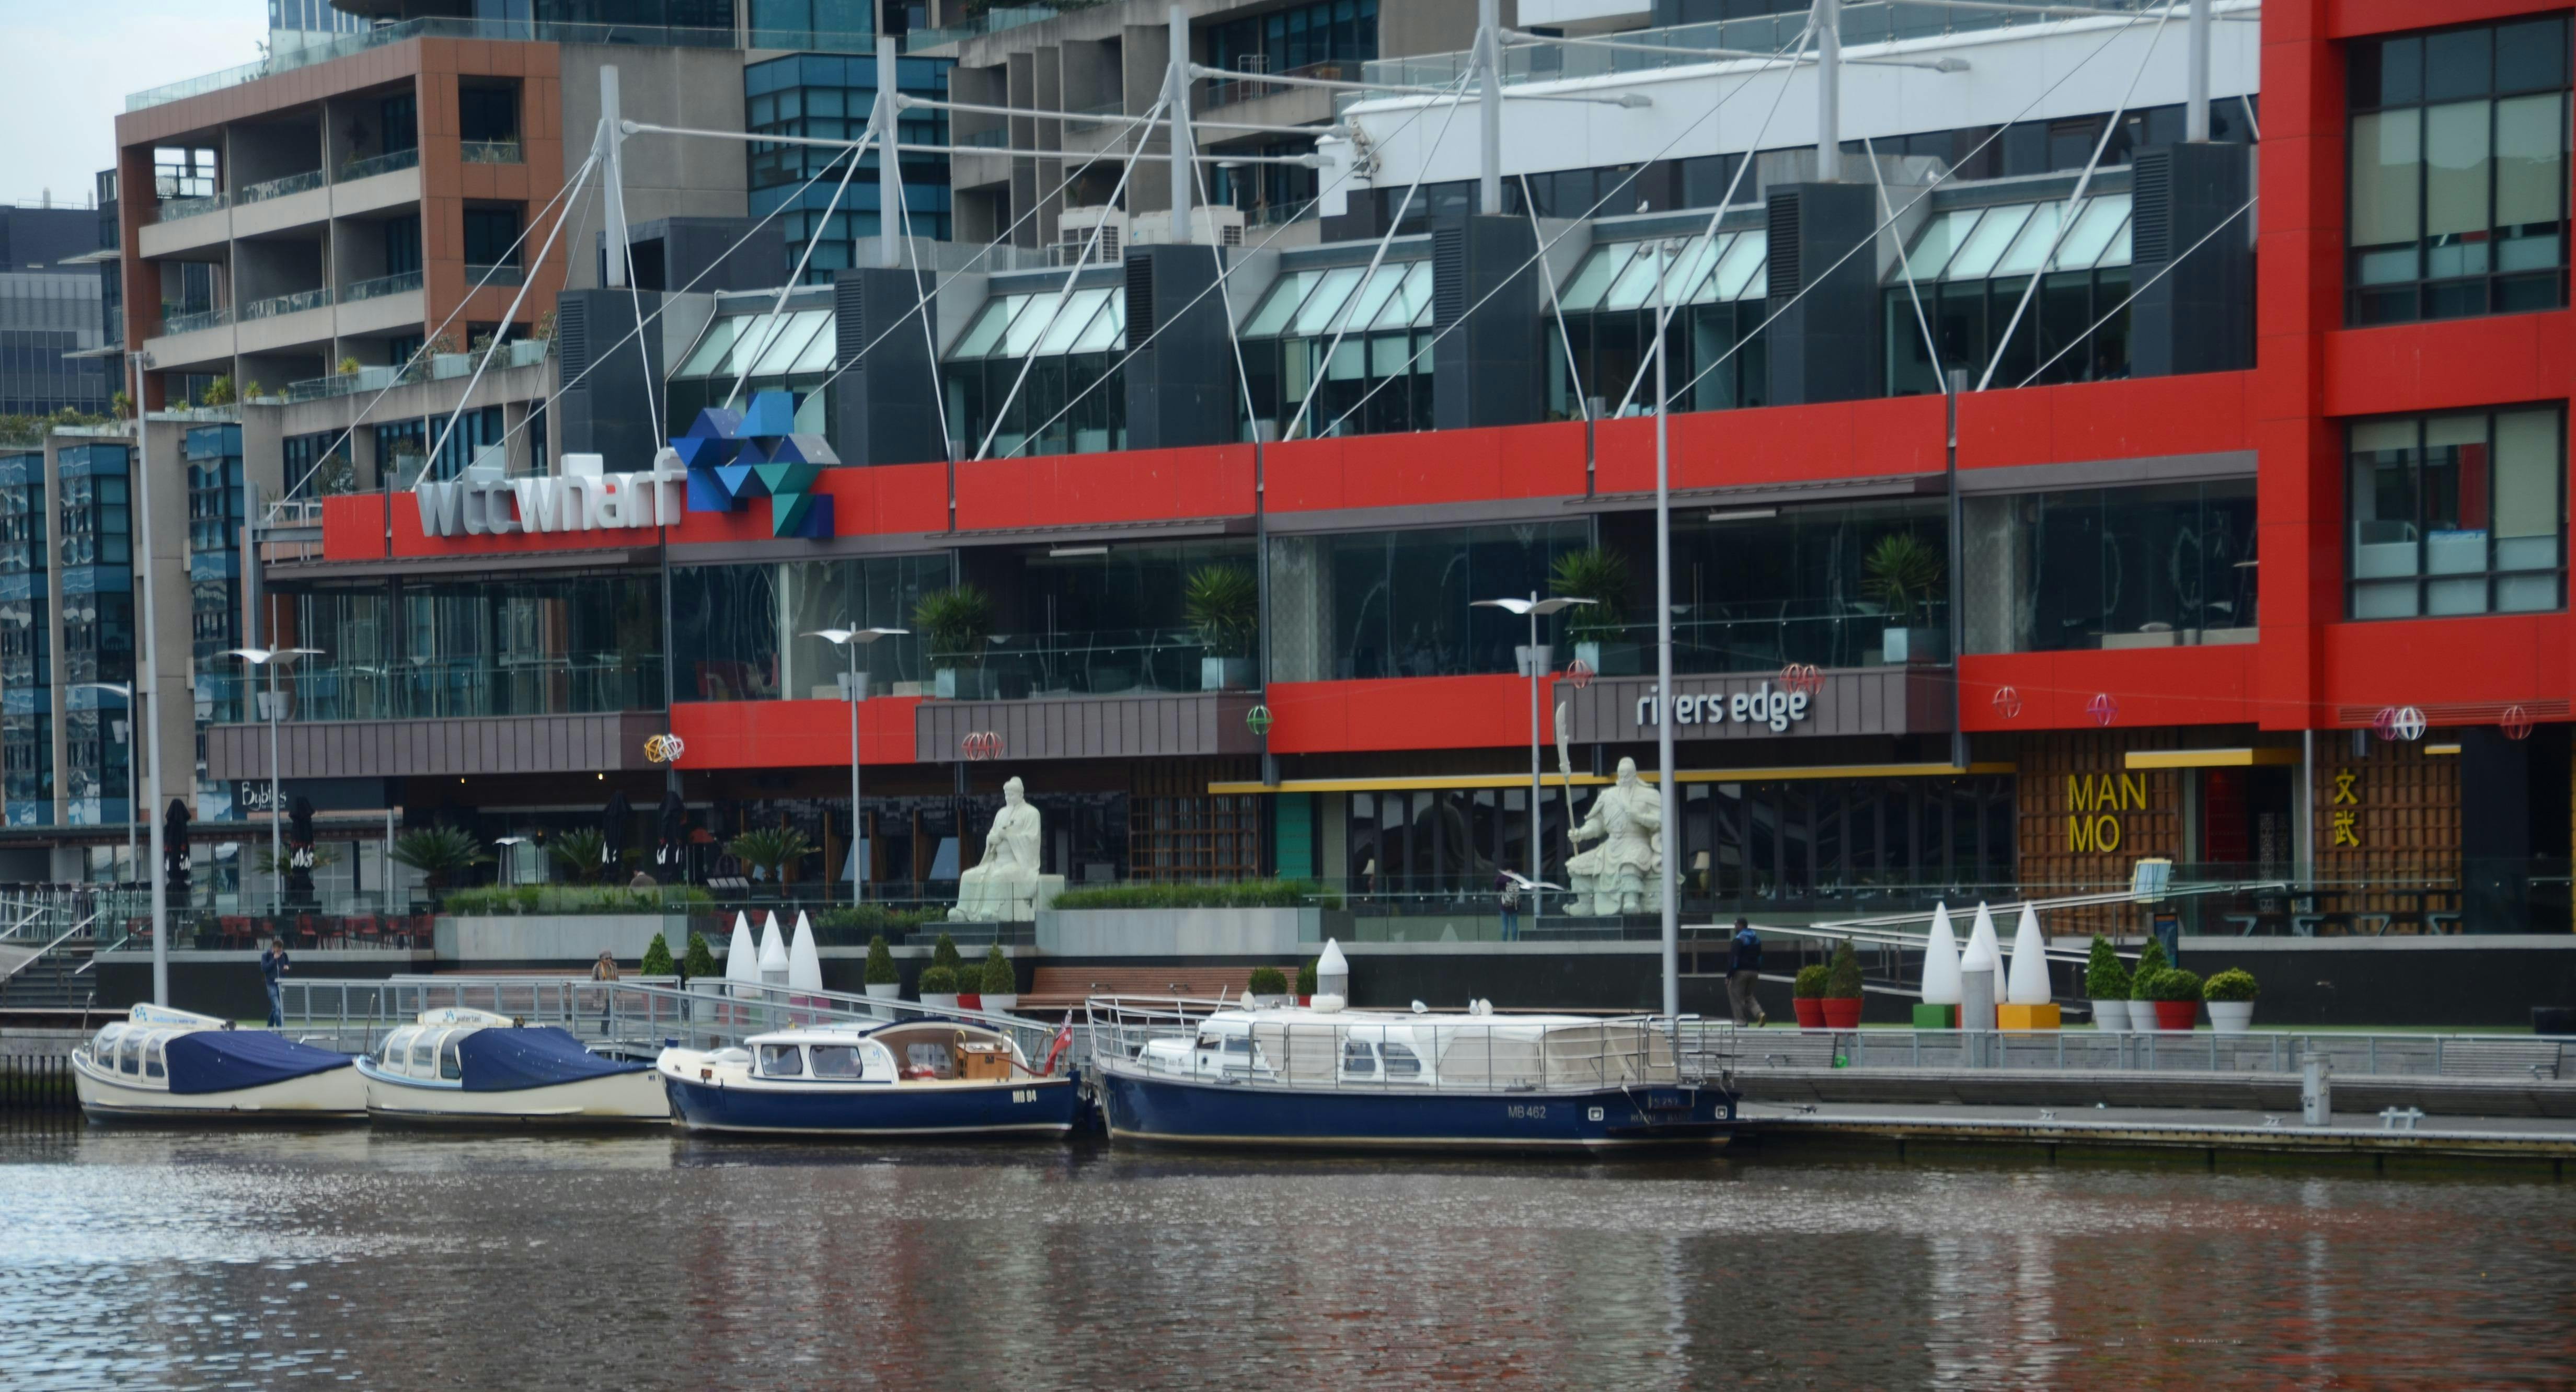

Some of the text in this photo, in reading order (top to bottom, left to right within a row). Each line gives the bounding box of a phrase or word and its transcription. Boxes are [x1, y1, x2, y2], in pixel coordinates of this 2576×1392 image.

[1637, 682, 1808, 732] riers edge
[242, 781, 287, 811] Bybls
[2068, 773, 2146, 812] MAN
[2333, 767, 2360, 847] 文武
[2068, 814, 2120, 853] MO
[1508, 1105, 1546, 1119] MB 462
